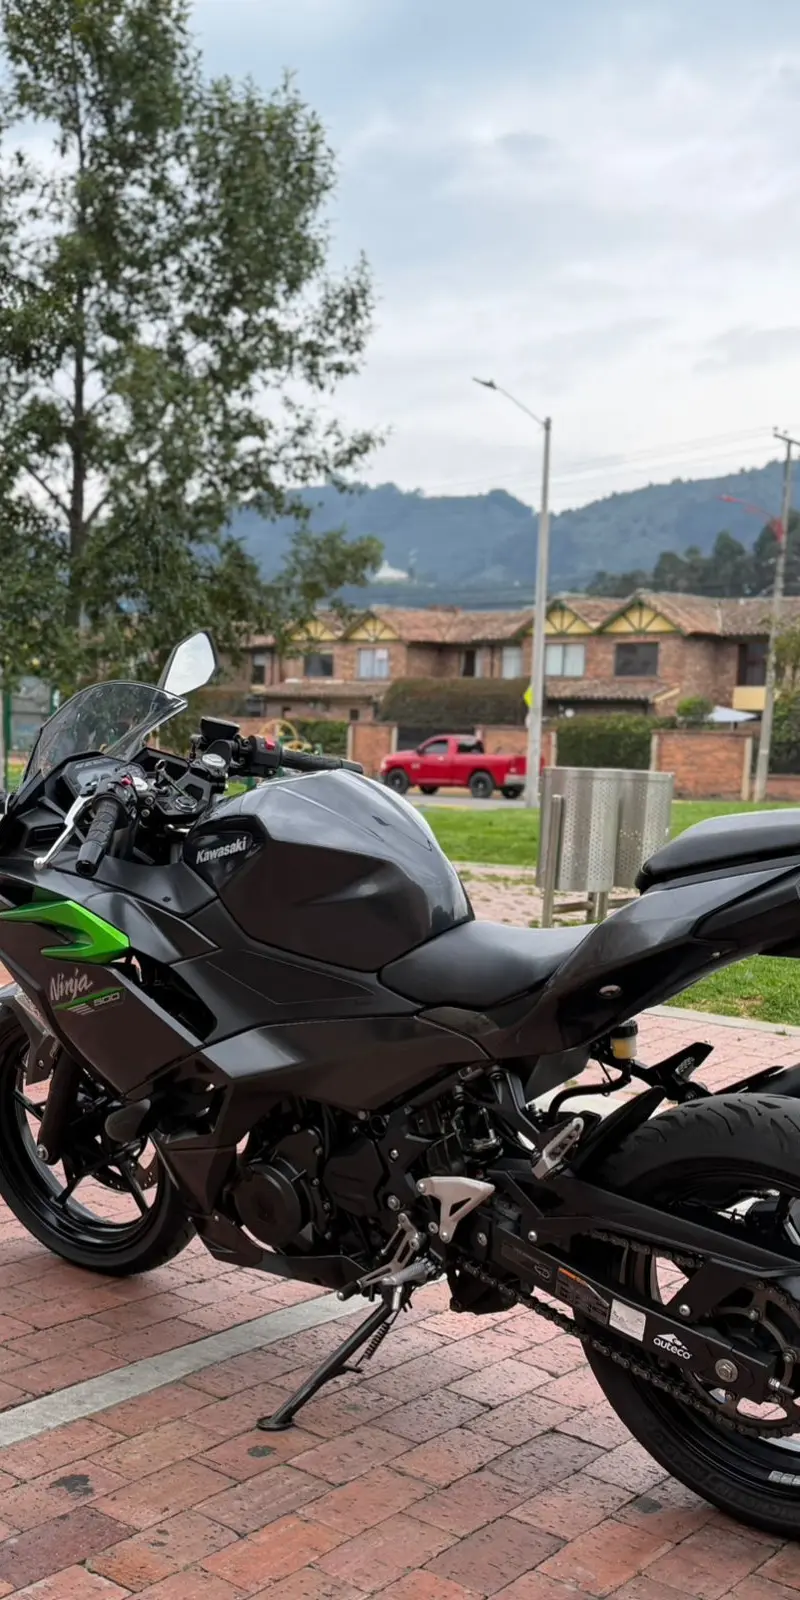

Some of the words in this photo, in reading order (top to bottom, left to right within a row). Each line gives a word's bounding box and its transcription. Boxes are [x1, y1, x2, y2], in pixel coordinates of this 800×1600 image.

[196, 836, 247, 865] Kawasaki
[50, 967, 93, 1003] Ninja
[653, 1337, 691, 1360] auteco
